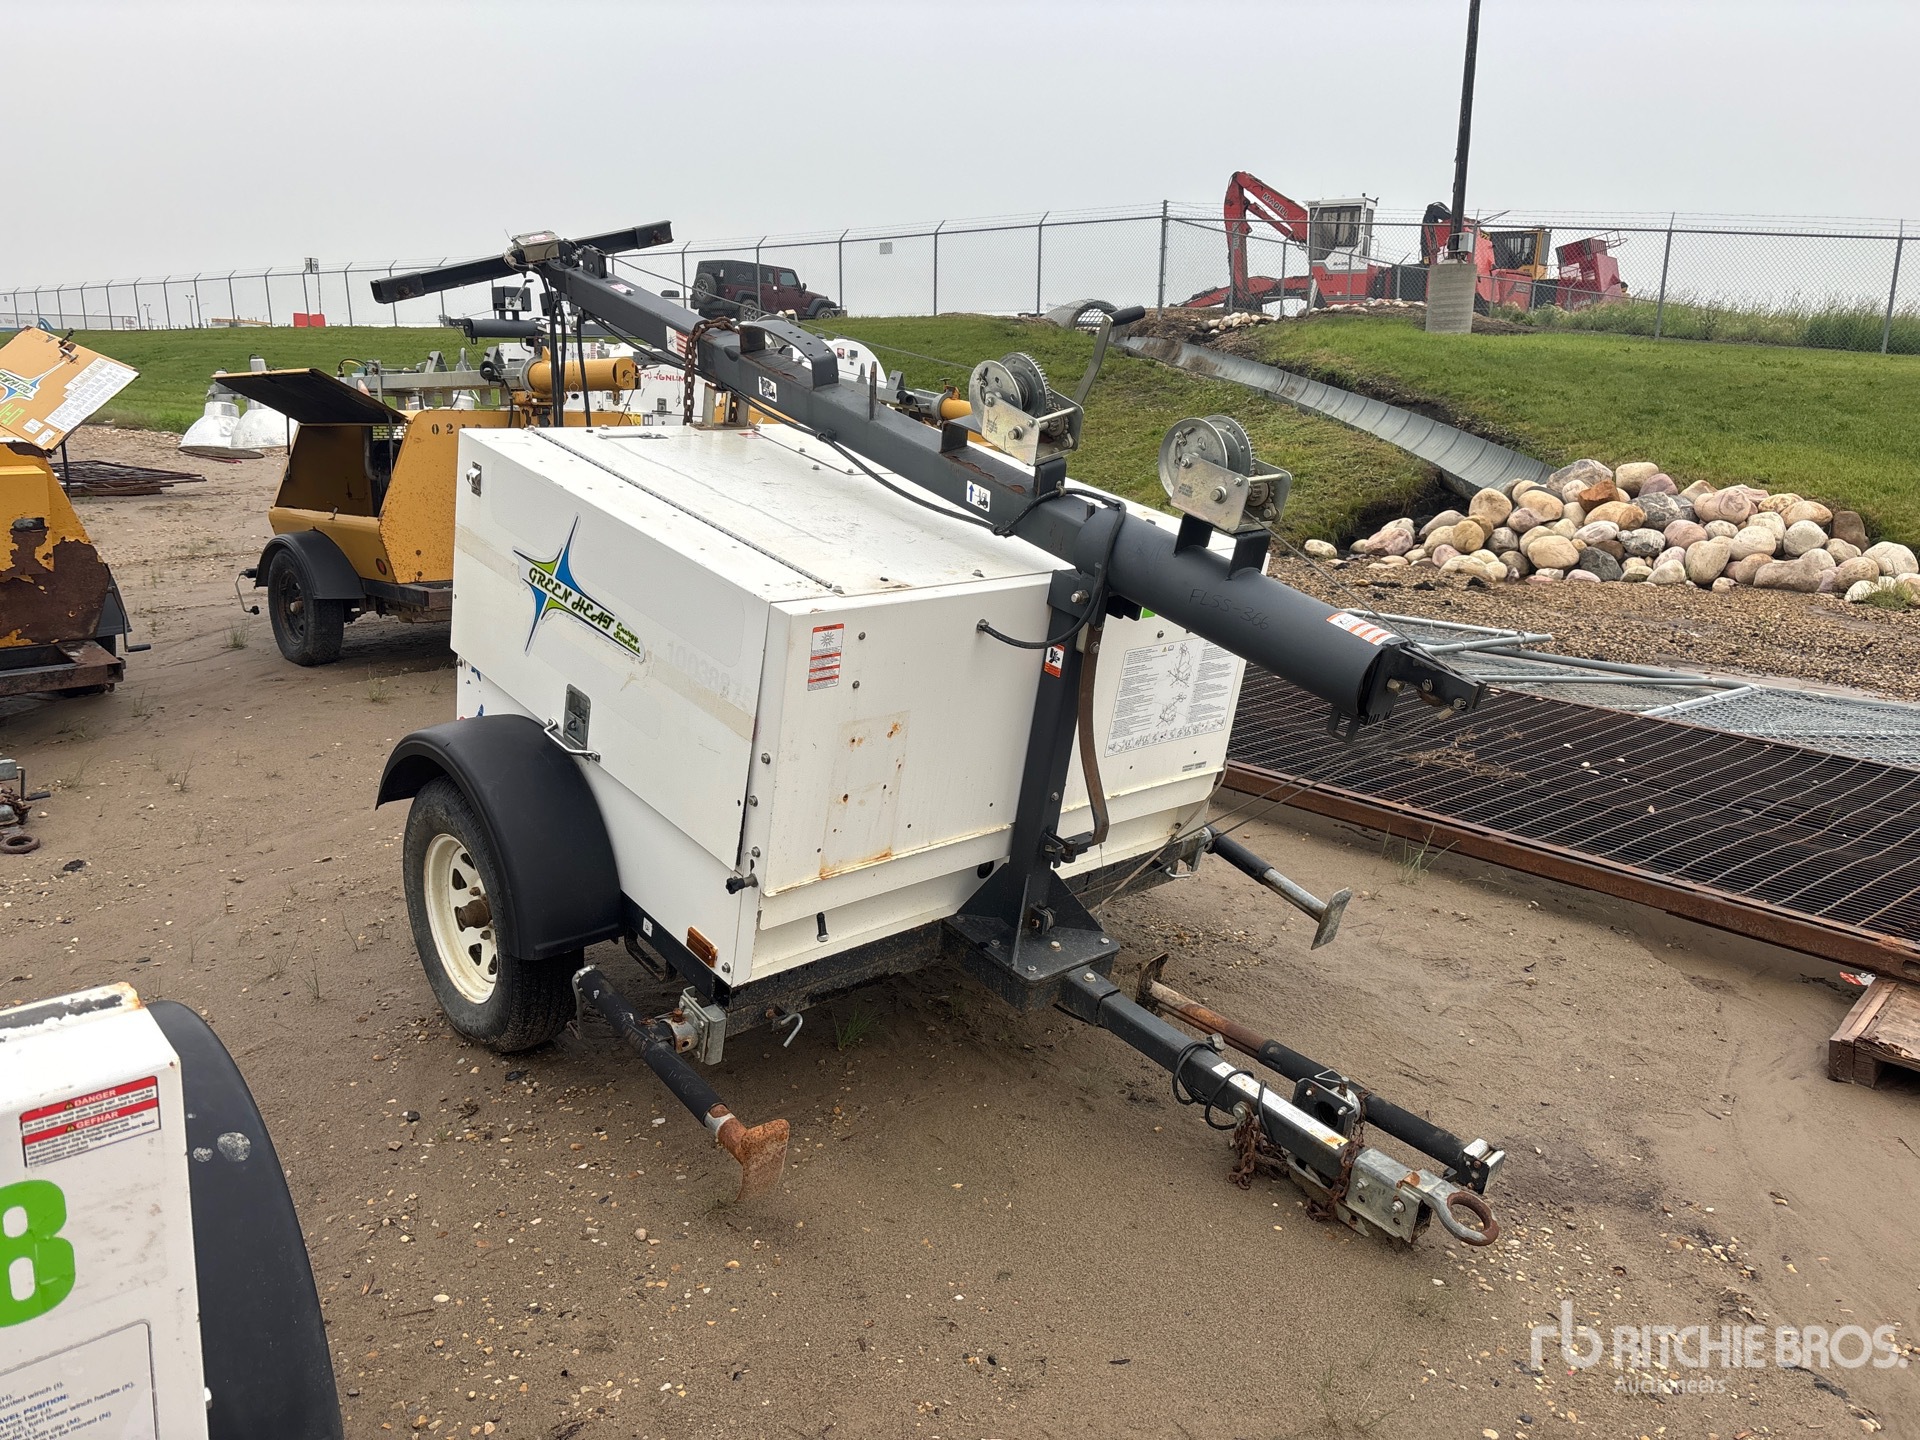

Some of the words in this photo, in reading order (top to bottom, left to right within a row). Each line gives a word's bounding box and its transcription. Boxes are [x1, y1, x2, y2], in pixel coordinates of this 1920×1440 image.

[1262, 193, 1289, 218] MADILL
[529, 567, 573, 603] GREEN
[571, 596, 616, 630] HEAT
[613, 631, 641, 654] Services
[616, 621, 640, 645] Energy
[74, 1089, 117, 1107] DANGER
[76, 1111, 119, 1129] GEFHAR
